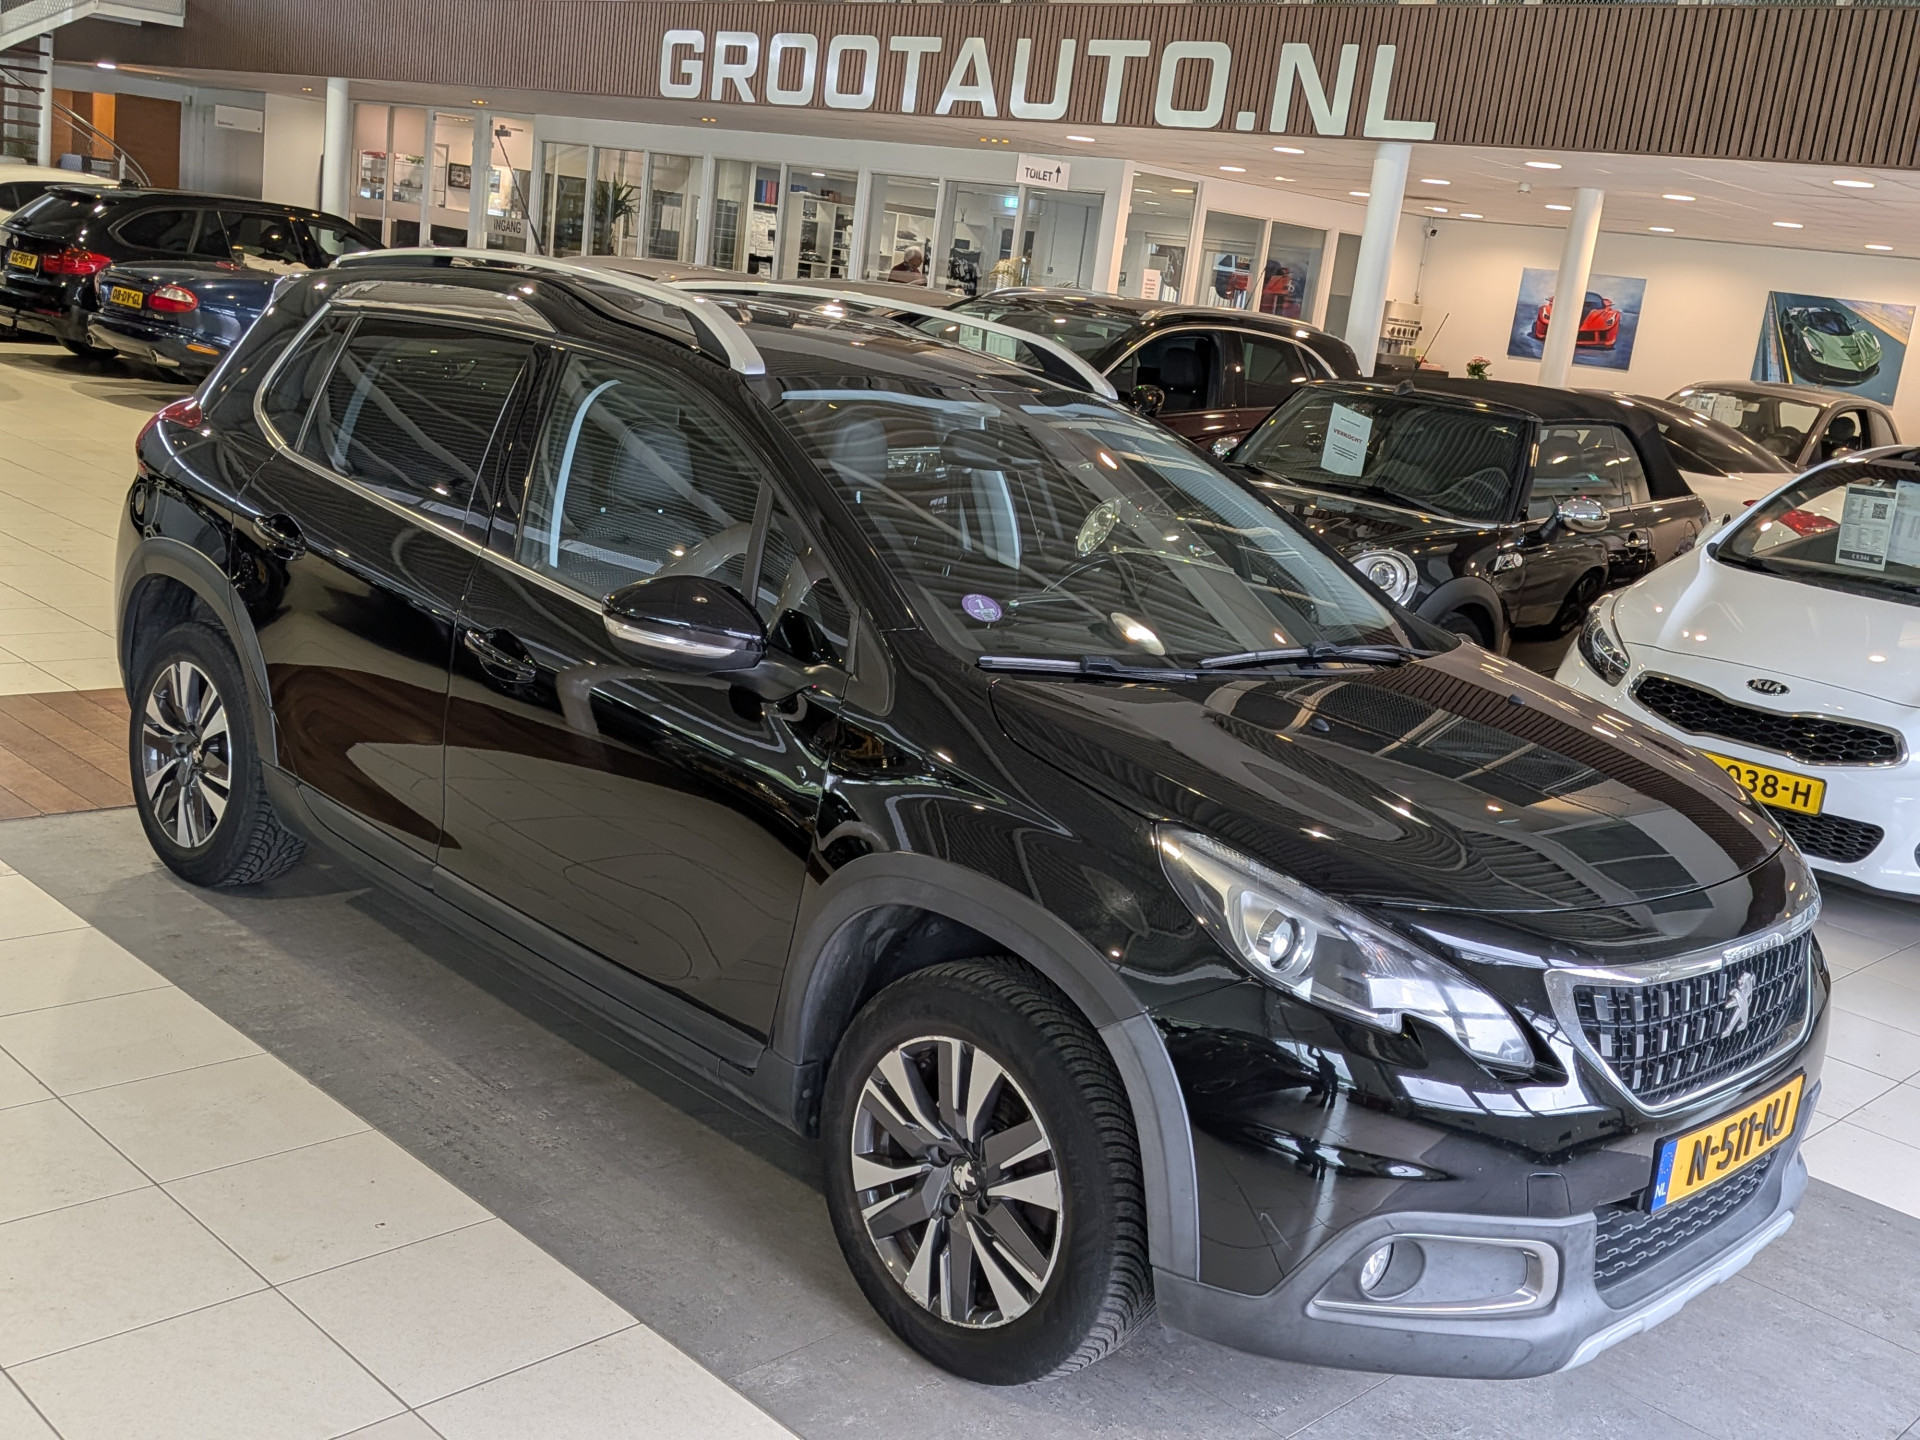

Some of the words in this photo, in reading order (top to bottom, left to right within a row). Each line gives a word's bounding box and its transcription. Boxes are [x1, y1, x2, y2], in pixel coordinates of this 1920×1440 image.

[659, 29, 1436, 141] GROOTAUTO.NL
[1025, 167, 1053, 182] TOILET
[494, 219, 522, 234] INGANG
[1333, 427, 1363, 444] VERKOCHT
[1752, 680, 1782, 693] KIA
[1654, 1182, 1667, 1199] NL
